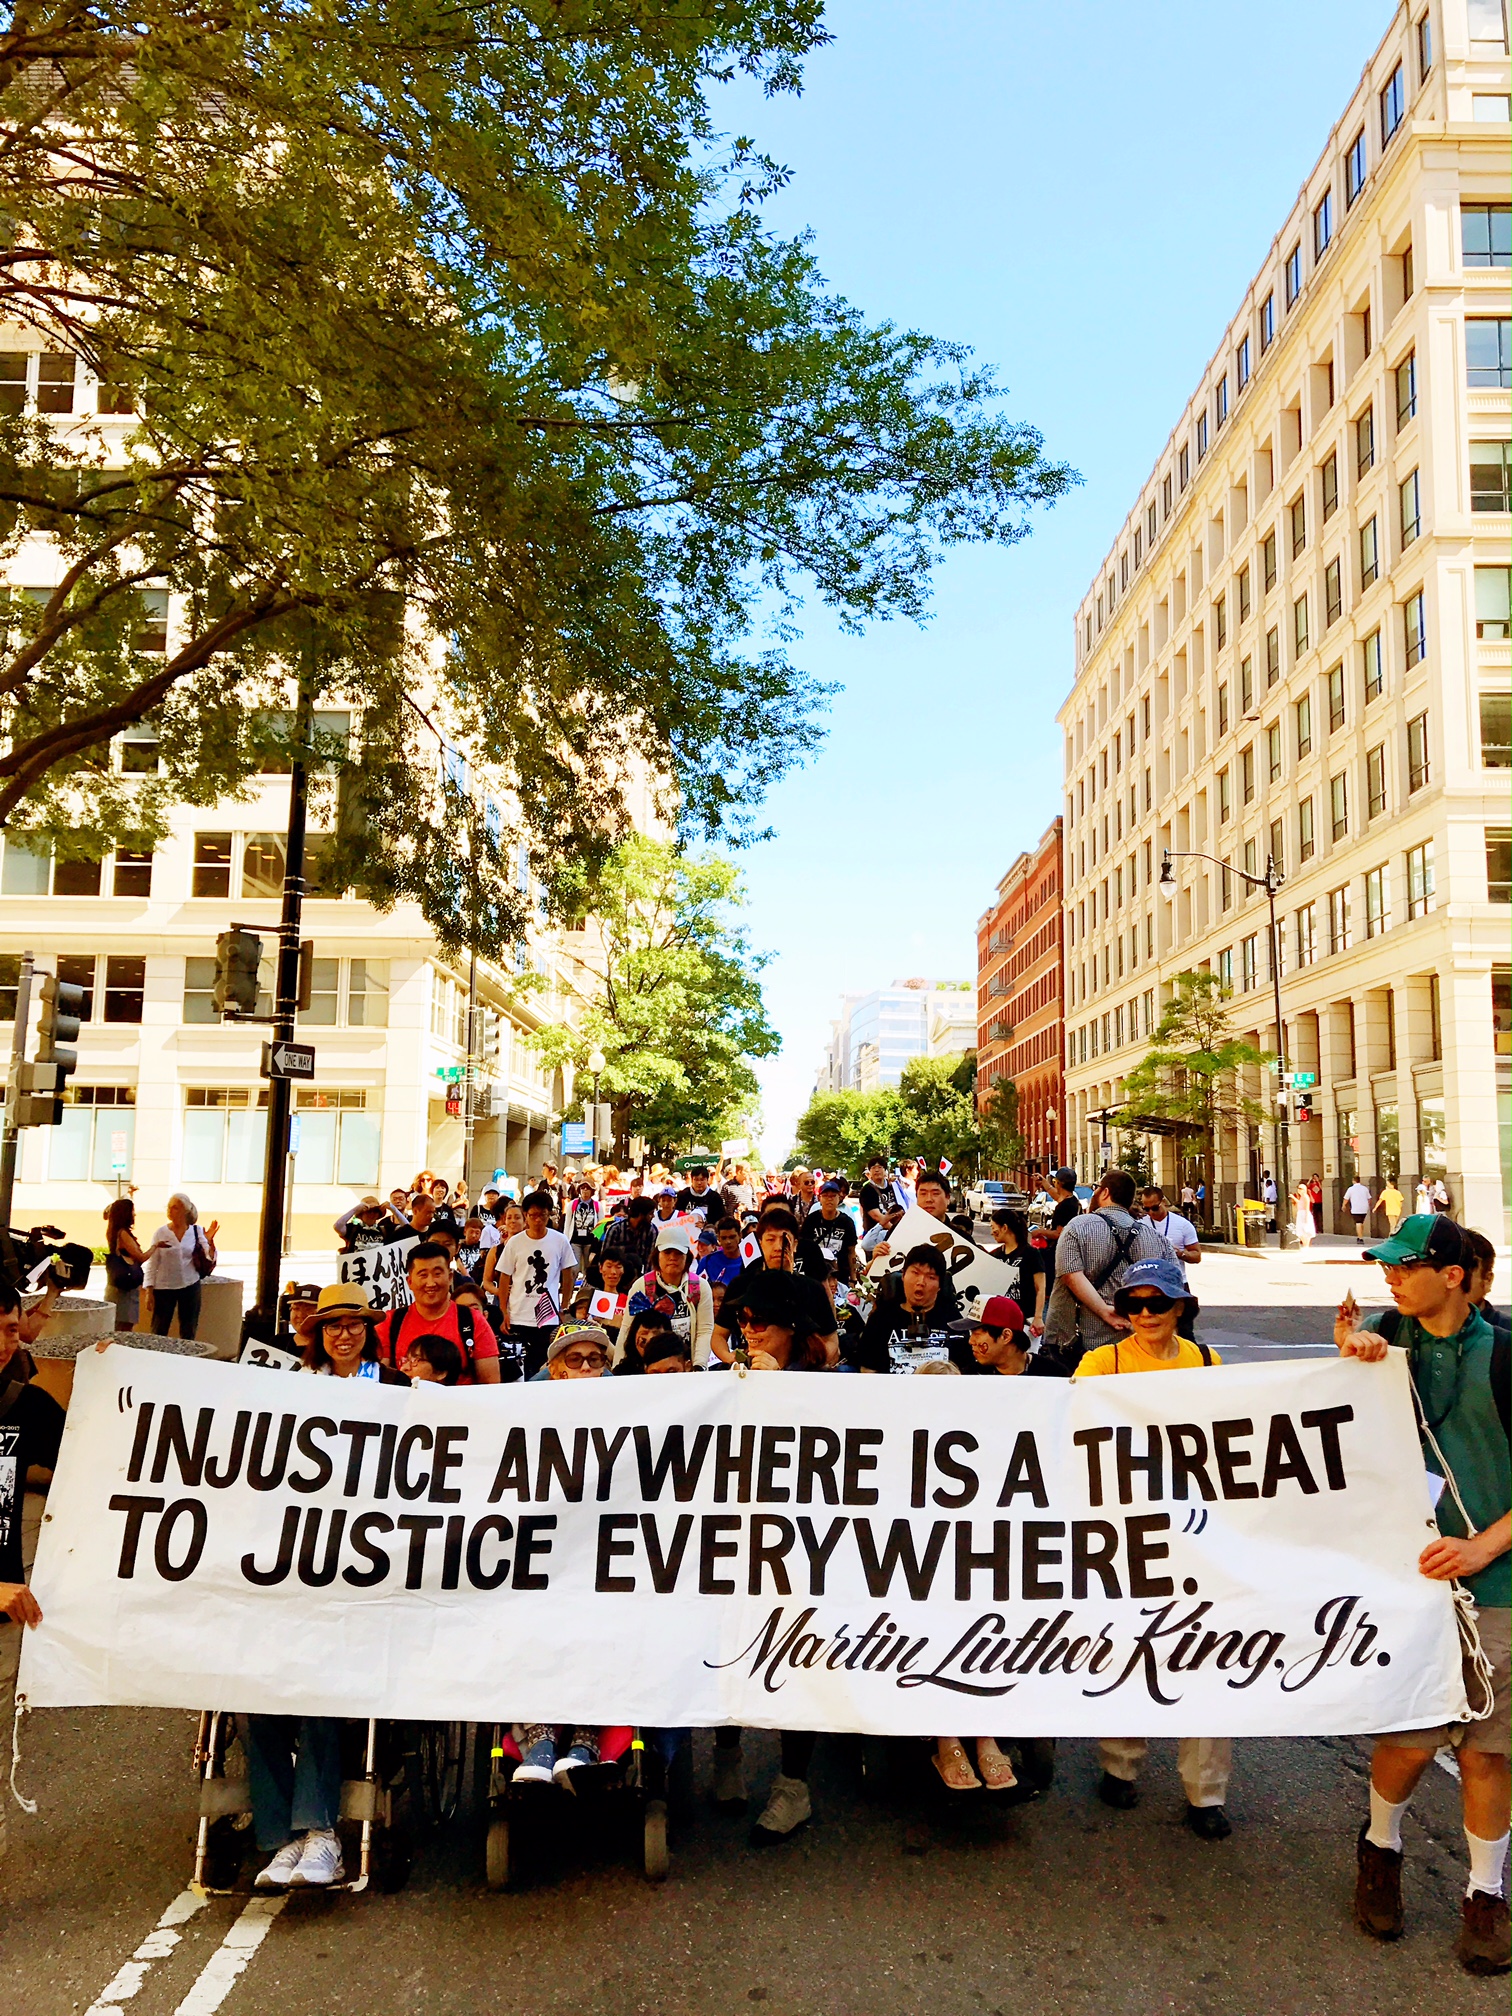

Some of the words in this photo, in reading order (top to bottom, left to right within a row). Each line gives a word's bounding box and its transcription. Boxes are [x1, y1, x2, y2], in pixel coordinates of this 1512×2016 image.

[284, 1053, 297, 1067] ONE
[298, 1055, 311, 1069] WAY
[1132, 1264, 1159, 1273] ADAPT
[119, 1387, 468, 1503] "INJUSTICE
[488, 1425, 883, 1506] ANYWHERE
[911, 1429, 980, 1509] IS
[996, 1430, 1050, 1509] A
[1074, 1405, 1353, 1507] THREAT
[109, 1495, 207, 1582] TO
[241, 1506, 557, 1591] JUSTICE
[595, 1509, 1207, 1601] EVERYWHERE."
[703, 1607, 929, 1693] Martin
[897, 1610, 1114, 1696] Luther
[1082, 1601, 1286, 1705] King,
[1278, 1597, 1391, 1693] Jr.
